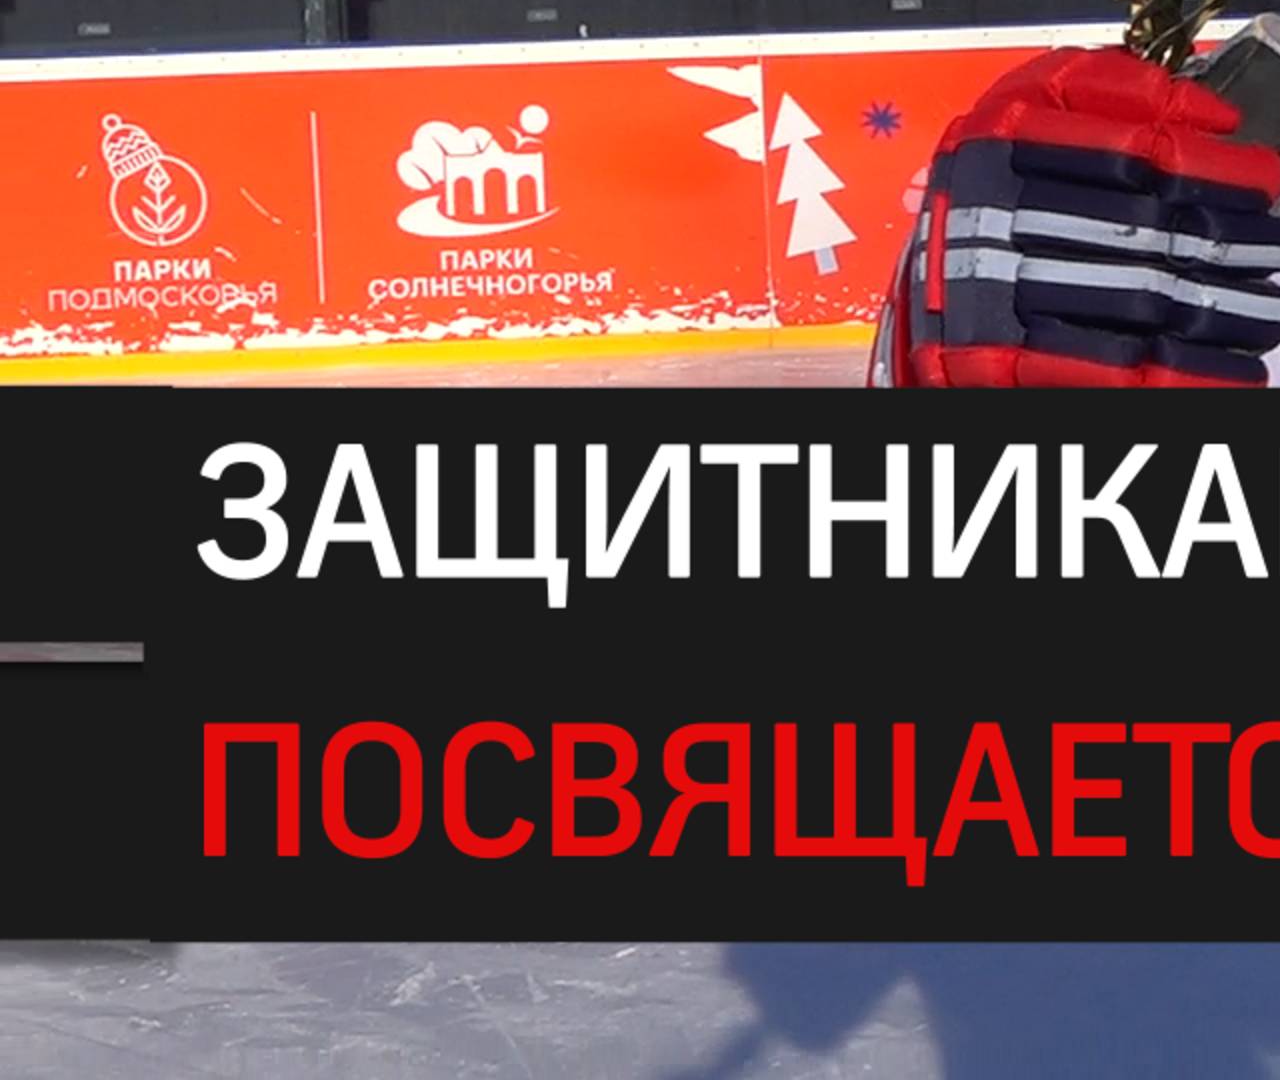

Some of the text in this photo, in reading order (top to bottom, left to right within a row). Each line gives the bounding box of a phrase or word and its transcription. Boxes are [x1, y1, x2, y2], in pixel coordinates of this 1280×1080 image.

[113, 258, 212, 282] ПАРКИ
[440, 247, 534, 270] ПАРКИ
[48, 281, 278, 313] ПОДМОСКОВЬЯ
[367, 270, 613, 300] СОЛНЕЧНОГОРЬЯ
